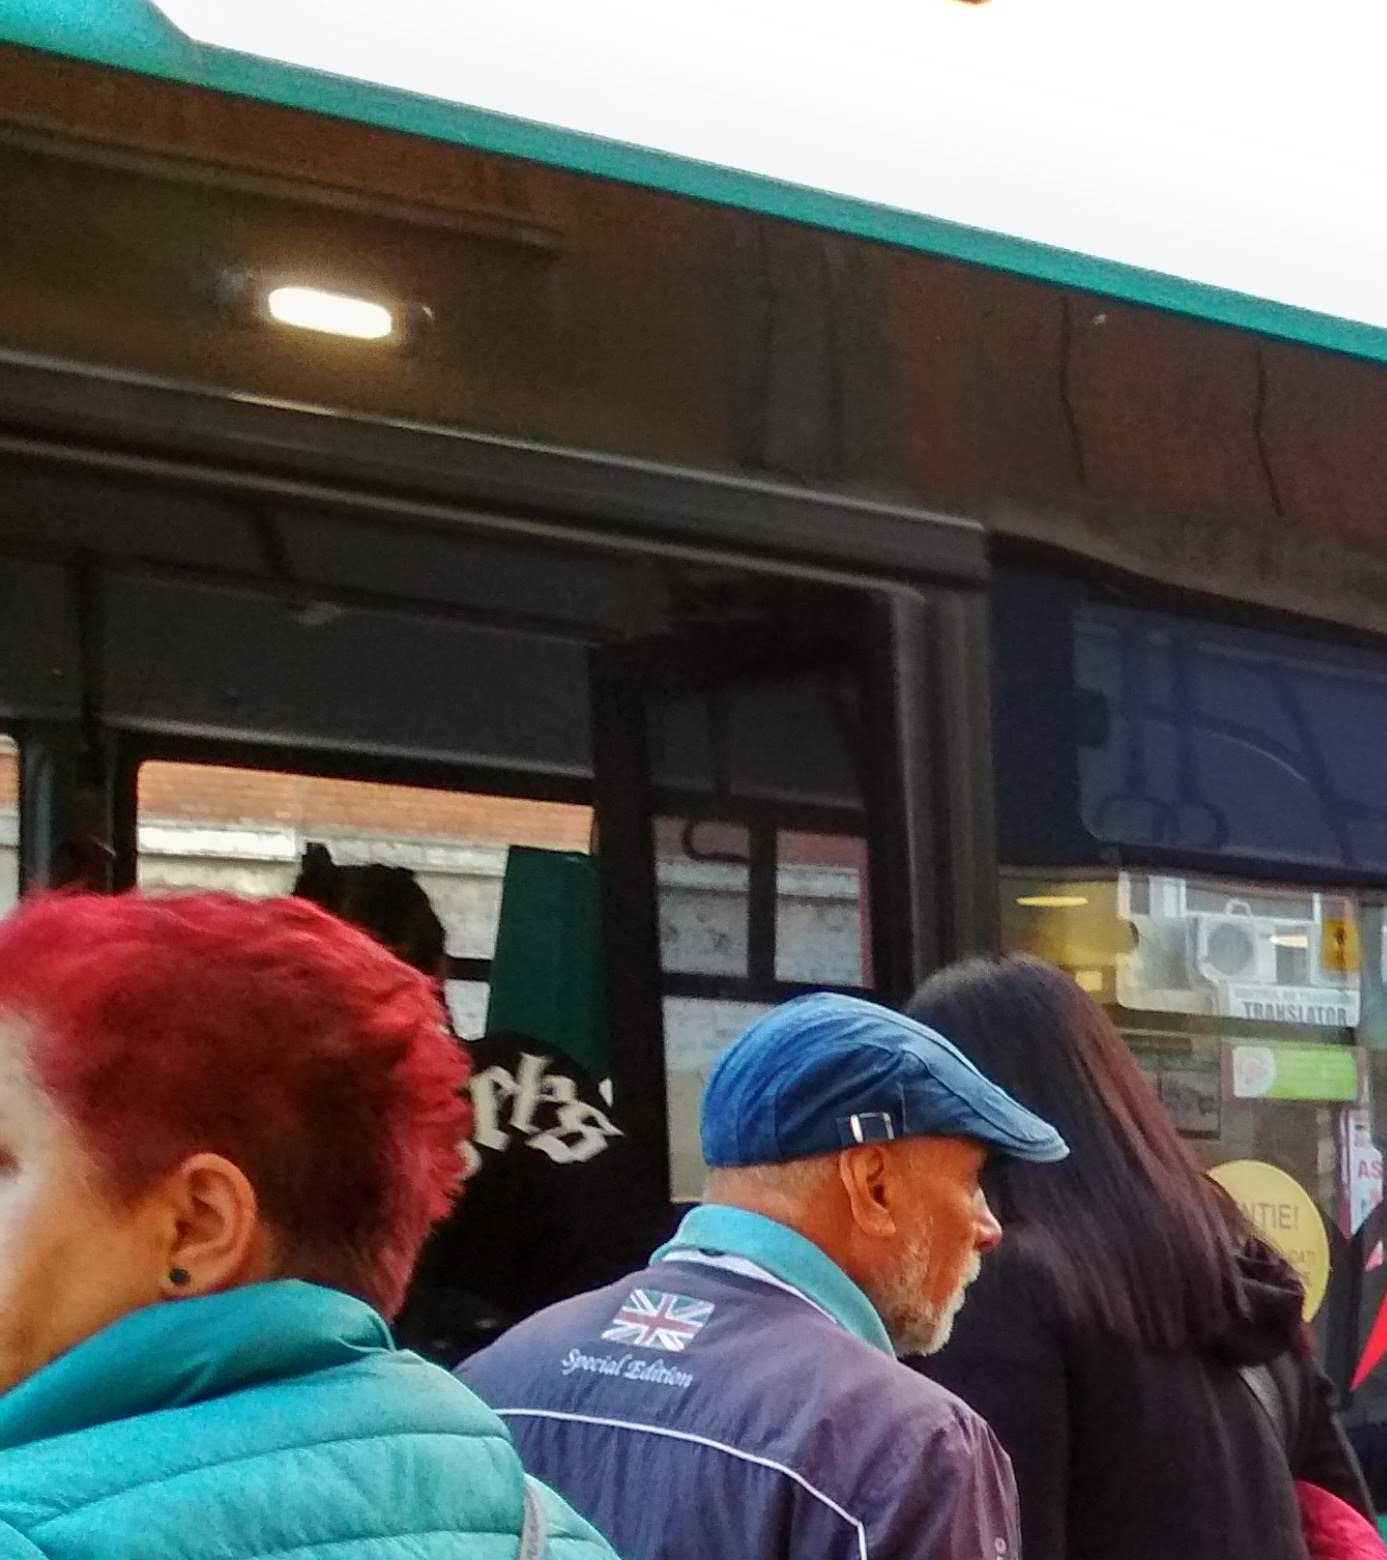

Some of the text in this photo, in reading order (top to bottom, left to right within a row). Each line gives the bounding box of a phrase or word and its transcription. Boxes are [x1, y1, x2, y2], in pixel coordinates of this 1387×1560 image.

[1242, 1000, 1348, 1028] TRANSLATOR
[561, 1348, 693, 1388] Special Edition
